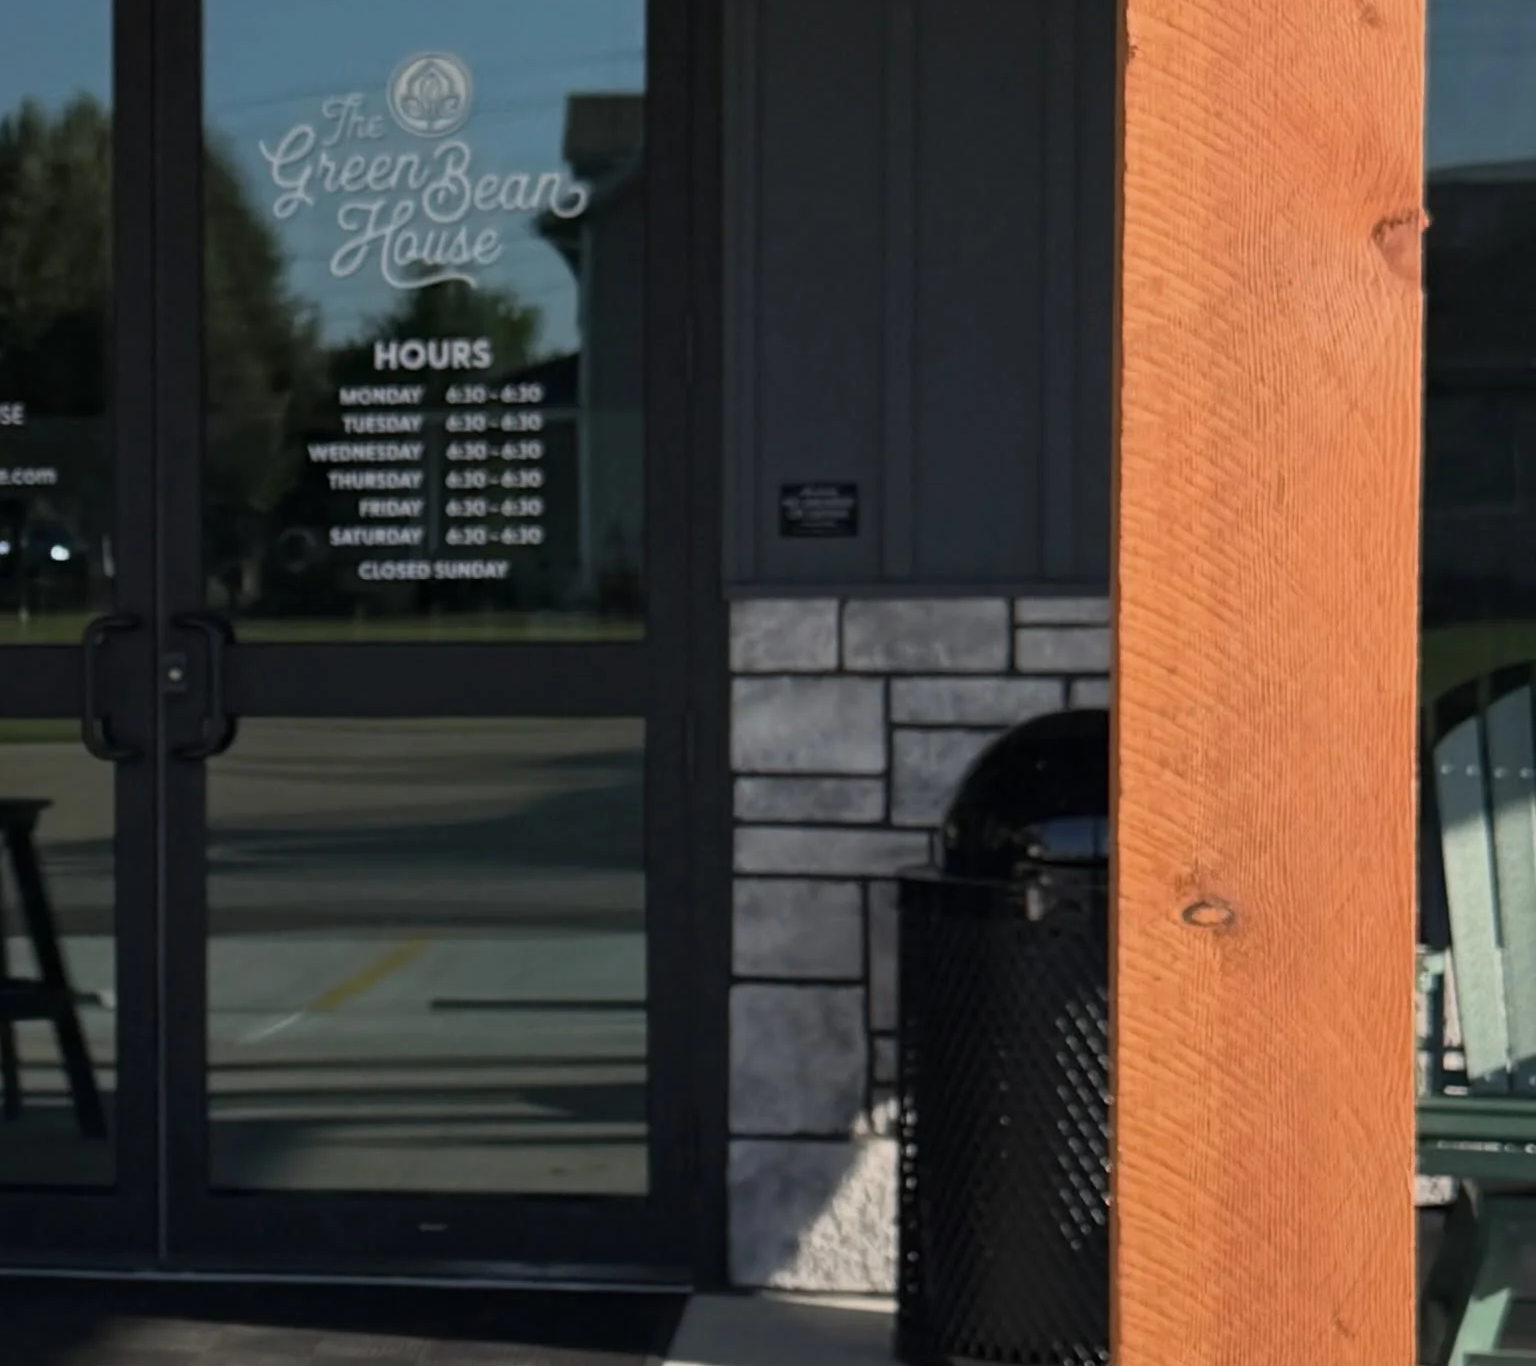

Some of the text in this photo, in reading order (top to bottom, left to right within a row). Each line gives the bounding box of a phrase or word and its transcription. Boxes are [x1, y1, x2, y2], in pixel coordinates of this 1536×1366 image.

[321, 92, 385, 147] The
[258, 124, 589, 223] Green Bean
[329, 198, 504, 290] House
[374, 338, 494, 371] HOURS
[339, 386, 424, 406] MONDAY
[341, 413, 424, 433] TUESDAY
[307, 441, 424, 462] WEDNESDAY
[327, 469, 424, 490] THURSDAY
[358, 497, 424, 517] FRIDAY
[329, 525, 424, 546] SATURDAY
[358, 560, 509, 580] CLOSED SUNDAY
